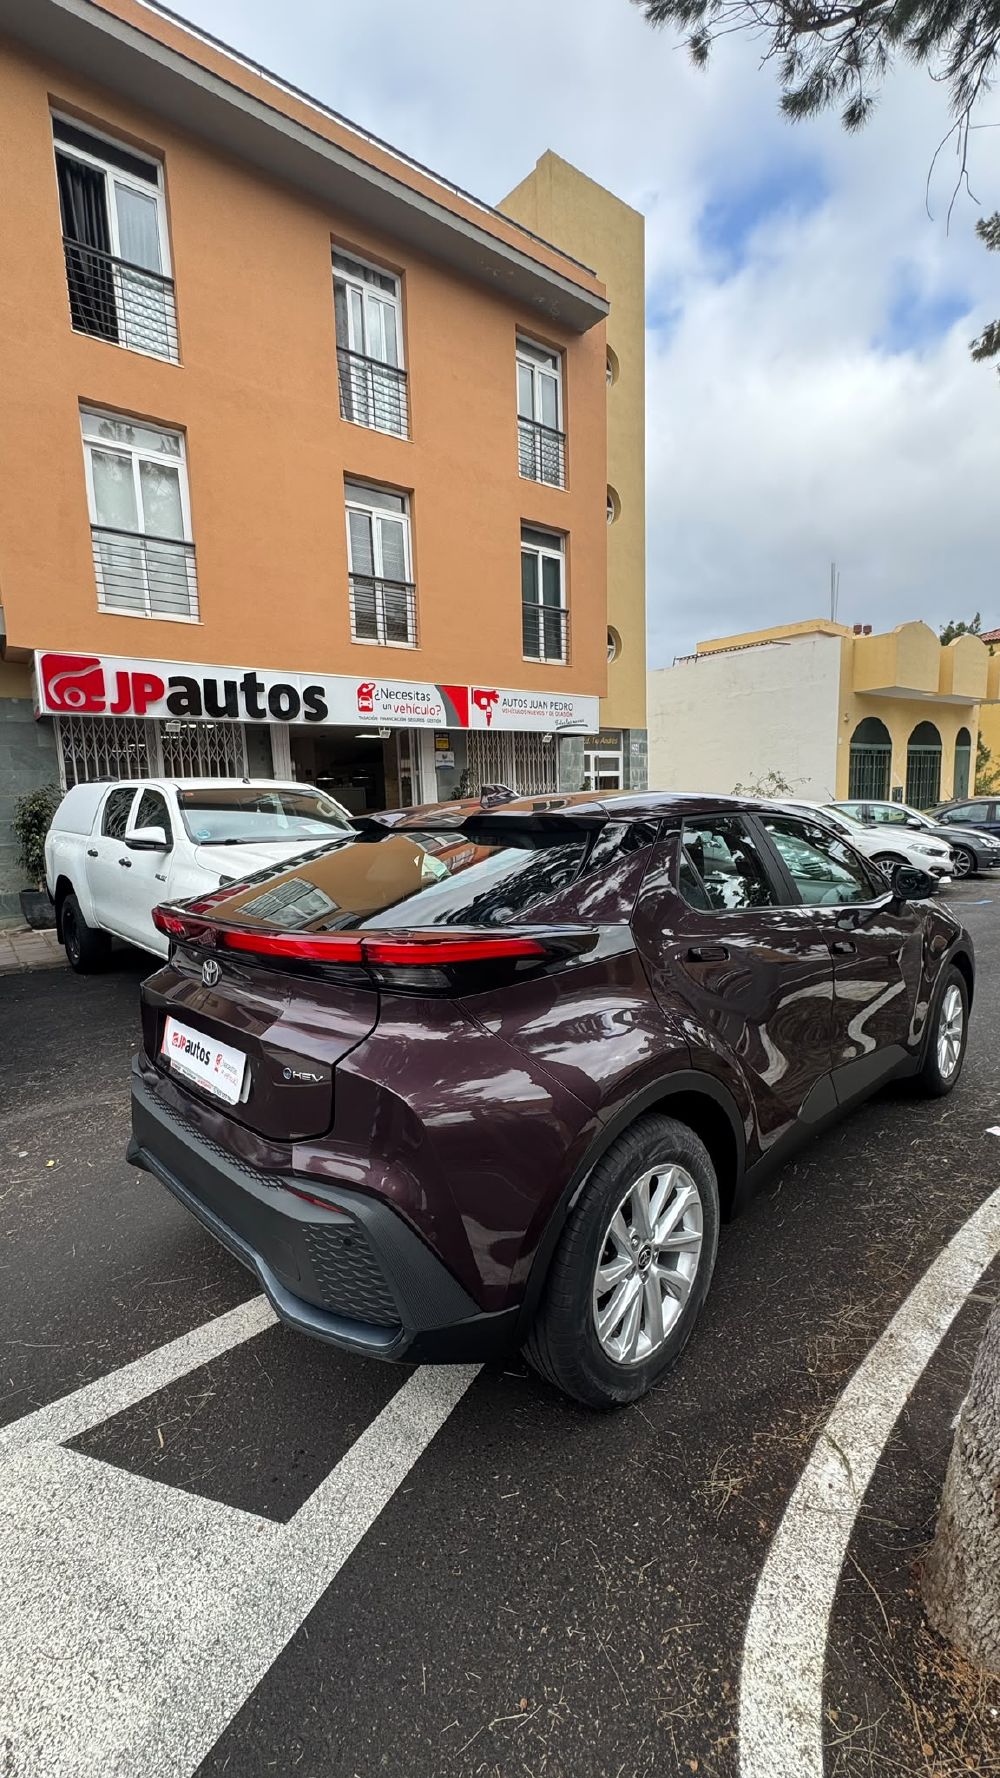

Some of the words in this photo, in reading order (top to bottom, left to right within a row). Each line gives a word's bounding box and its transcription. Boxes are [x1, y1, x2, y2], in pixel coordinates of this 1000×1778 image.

[109, 671, 329, 722] JPautos
[374, 687, 431, 702] ¿Necesitas
[393, 702, 442, 716] vehículo?
[502, 698, 528, 709] AUTOS
[529, 700, 547, 710] JUAN
[549, 701, 574, 712] PEDRO
[292, 1070, 324, 1082] HEV
